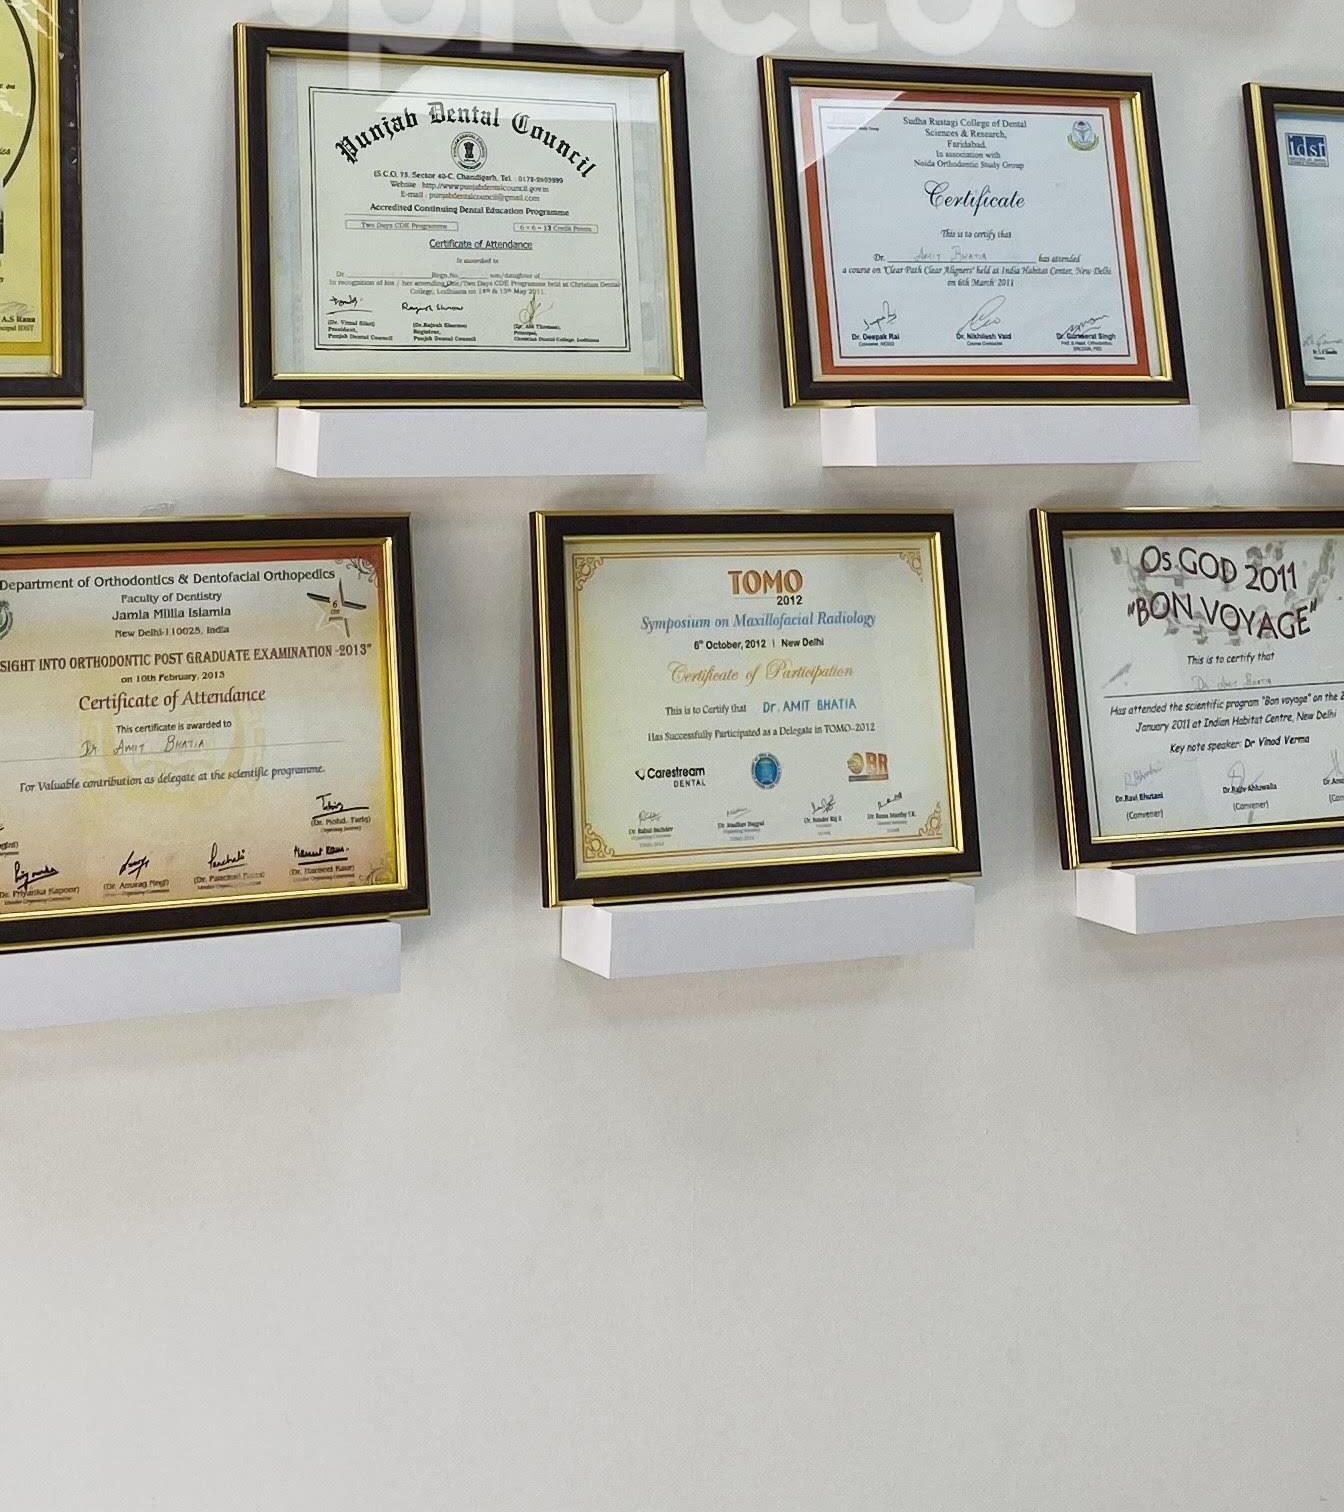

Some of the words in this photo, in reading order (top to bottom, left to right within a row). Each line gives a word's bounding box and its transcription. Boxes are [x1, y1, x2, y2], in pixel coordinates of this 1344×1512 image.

[959, 119, 990, 129] College
[991, 120, 1000, 128] of
[1002, 120, 1027, 128] Dental
[335, 107, 418, 164] Punjab
[428, 102, 500, 127] Dental
[512, 112, 597, 178] Council
[924, 180, 1025, 216] Certificate
[370, 203, 412, 212] Accredited
[415, 204, 457, 214] Continuing
[460, 206, 484, 214] Dental
[485, 207, 523, 216] Education
[526, 208, 569, 216] Programme
[430, 239, 473, 248] Certificate
[475, 240, 484, 249] of
[485, 240, 533, 249] Attendance
[1141, 546, 1171, 574] Os
[1179, 547, 1237, 583] GOD
[1245, 562, 1297, 592] 2011
[0, 578, 74, 592] Department
[77, 576, 91, 588] of
[94, 573, 175, 587] Orthodontics
[178, 573, 189, 585] &
[194, 571, 261, 584] Dentofacial
[264, 568, 336, 585] Orthopedics
[728, 569, 803, 595] TOMO
[121, 592, 159, 604] Faculty
[162, 591, 173, 602] of
[176, 590, 222, 603] Dentistry
[777, 595, 803, 606] 2012
[112, 609, 148, 621] Jamia
[152, 607, 185, 619] Millia
[189, 606, 231, 618] Islamia
[640, 616, 710, 633] Symposium
[714, 616, 730, 628] on
[733, 612, 814, 629] Maxillofacial
[817, 611, 876, 628] Radiology
[1127, 592, 1193, 627] "BON
[1199, 596, 1317, 640] VOYAGE"
[706, 639, 743, 651] October,
[745, 639, 766, 649] 2012
[781, 638, 800, 648] New
[802, 637, 824, 647] Delhi
[39, 657, 66, 671] INTO
[69, 653, 151, 670] ORTHODONTIC
[154, 652, 183, 666] POST
[186, 649, 250, 665] GRADUATE
[253, 644, 333, 661] EXAMINATION
[667, 661, 739, 687] Certificate
[745, 665, 760, 685] of
[766, 658, 854, 684] Participation
[79, 692, 159, 715] Certificate
[163, 690, 179, 710] of
[181, 688, 266, 706] Attendance
[783, 699, 810, 713] AMIT
[817, 698, 856, 711] BHATIA
[1170, 743, 1185, 755] Key
[1187, 742, 1205, 752] note
[1207, 739, 1242, 751] speaker:
[1245, 739, 1256, 748] Dr
[1259, 736, 1282, 747] Vinod
[1284, 734, 1309, 745] Verma
[647, 766, 705, 779] Carestream
[674, 779, 706, 788] DENTAL
